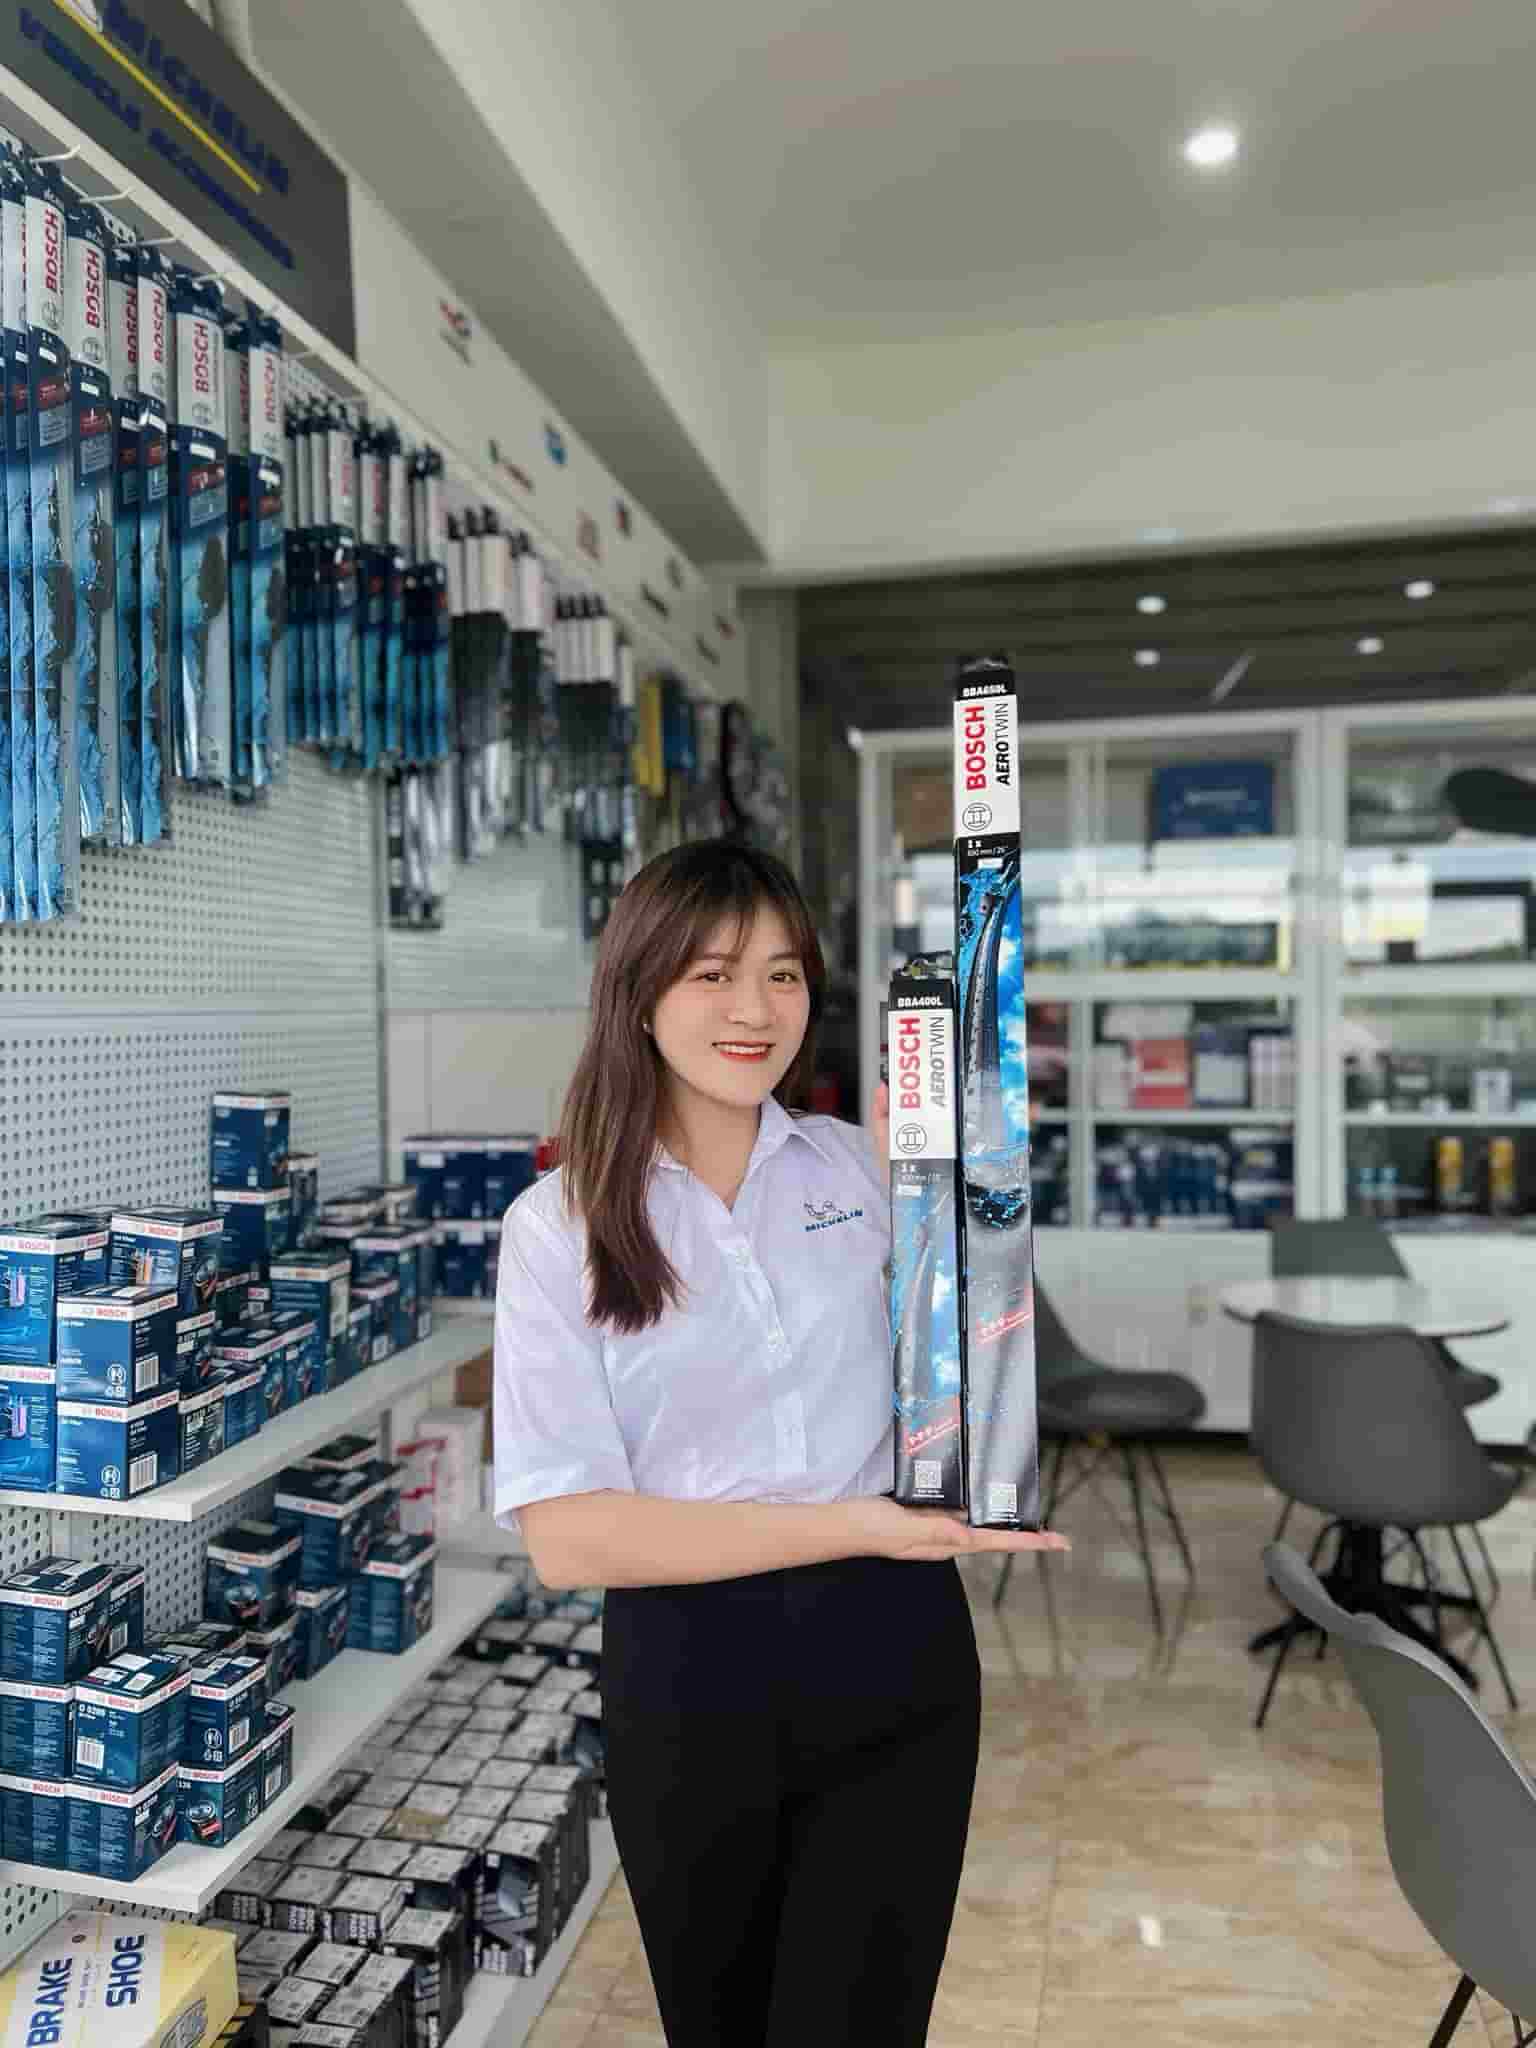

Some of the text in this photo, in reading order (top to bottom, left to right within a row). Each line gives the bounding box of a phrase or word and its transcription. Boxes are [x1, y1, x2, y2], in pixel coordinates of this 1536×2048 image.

[45, 208, 59, 293] BOSCH
[86, 248, 100, 328] BOSCH
[153, 289, 164, 363] BOSCH
[194, 321, 209, 393] BOSCH
[964, 705, 986, 791] BOSCH
[994, 703, 1010, 786] AEROTWIN
[898, 1017, 921, 1110] BOSCH
[929, 1016, 945, 1108] AEROTWIN
[805, 1208, 864, 1232] MICHELIN
[95, 1307, 128, 1317] BOSCH
[95, 1408, 124, 1418] BOSCH
[32, 1596, 63, 1607] BOSCH
[32, 1783, 62, 1794] BOSCH
[26, 1957, 73, 2048] BRAKE
[106, 1934, 145, 2008] SHOE
